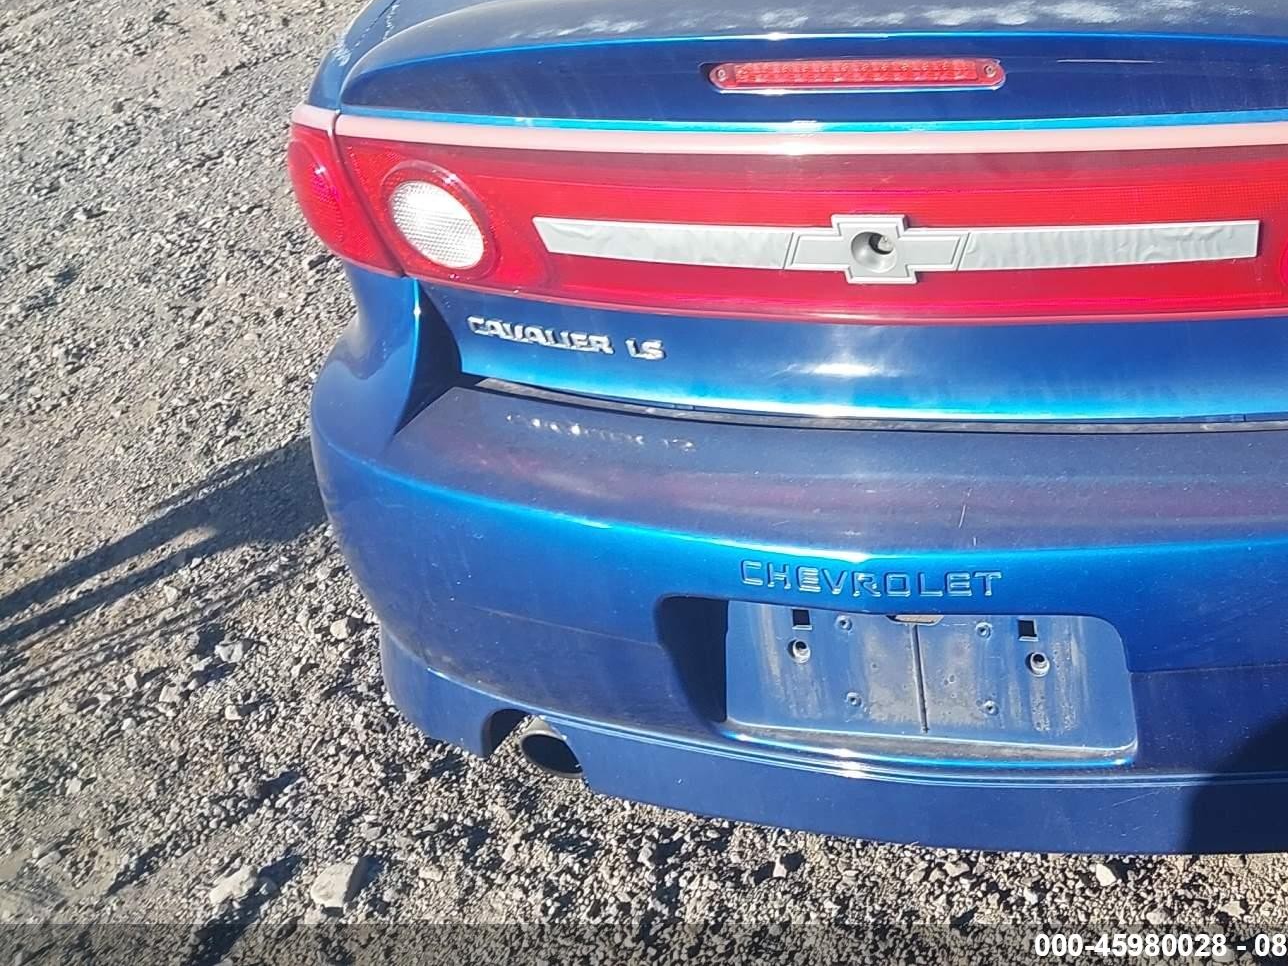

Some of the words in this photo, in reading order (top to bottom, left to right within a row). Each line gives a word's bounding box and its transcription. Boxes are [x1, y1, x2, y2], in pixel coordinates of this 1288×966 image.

[467, 315, 615, 355] CAVALIER
[625, 337, 666, 360] LS
[741, 560, 1003, 598] CHEVROLET
